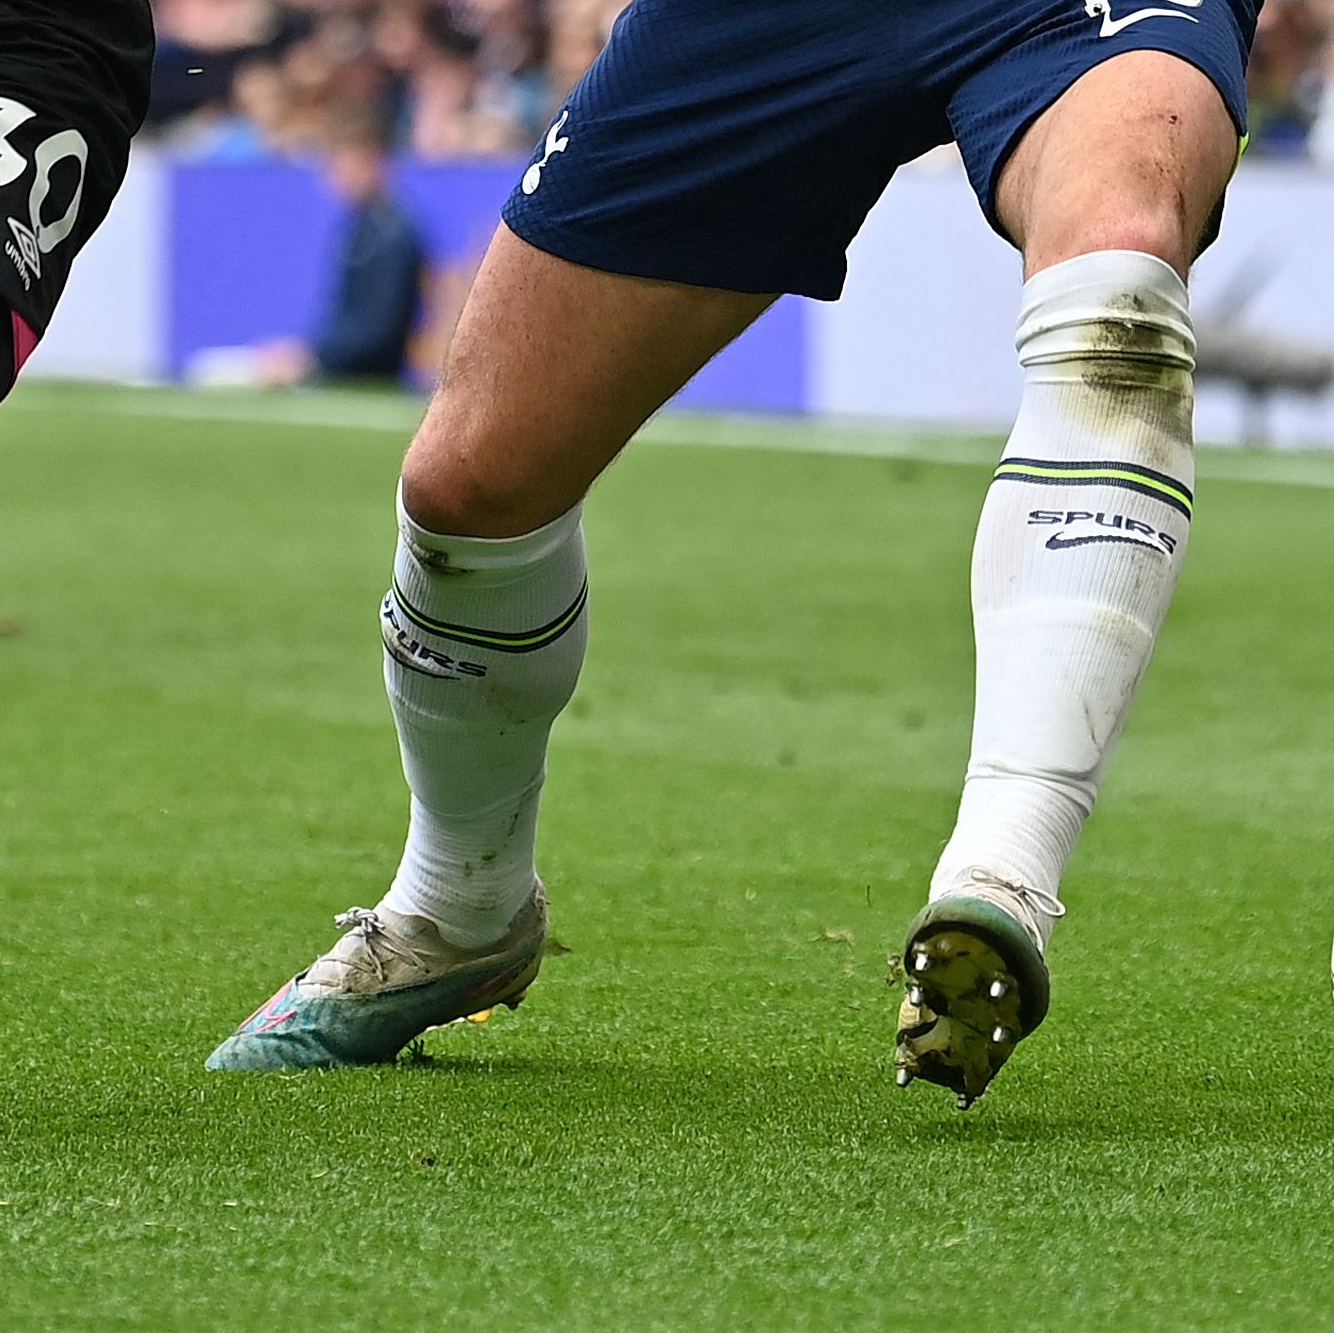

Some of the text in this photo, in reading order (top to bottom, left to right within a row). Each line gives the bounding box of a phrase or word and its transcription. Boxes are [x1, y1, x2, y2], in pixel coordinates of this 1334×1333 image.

[5, 240, 30, 291] umbro
[1027, 510, 1177, 555] SPURS
[384, 596, 488, 677] PURS
